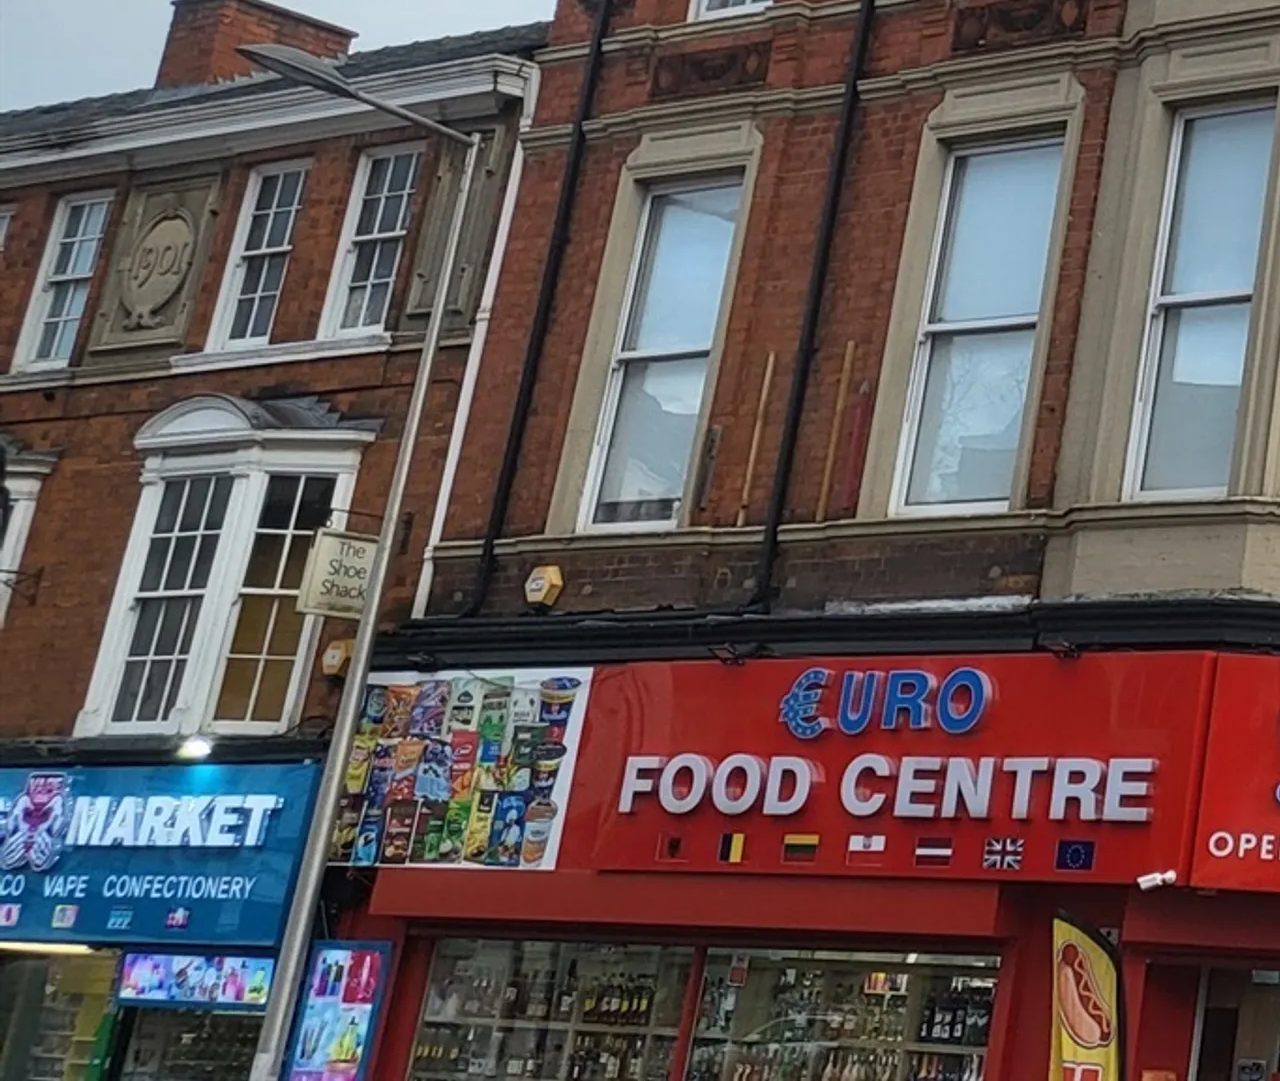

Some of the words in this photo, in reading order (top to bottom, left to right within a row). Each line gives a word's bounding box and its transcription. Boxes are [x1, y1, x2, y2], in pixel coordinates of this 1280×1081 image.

[132, 242, 189, 288] 1901
[339, 541, 367, 559] The
[326, 558, 368, 580] Shoe
[320, 578, 367, 601] Shack
[617, 752, 818, 818] FOOD
[839, 752, 1156, 822] CENTRE
[64, 794, 279, 848] MARKET
[43, 874, 91, 899] VAPE
[102, 875, 257, 900] CONFECTIONERY
